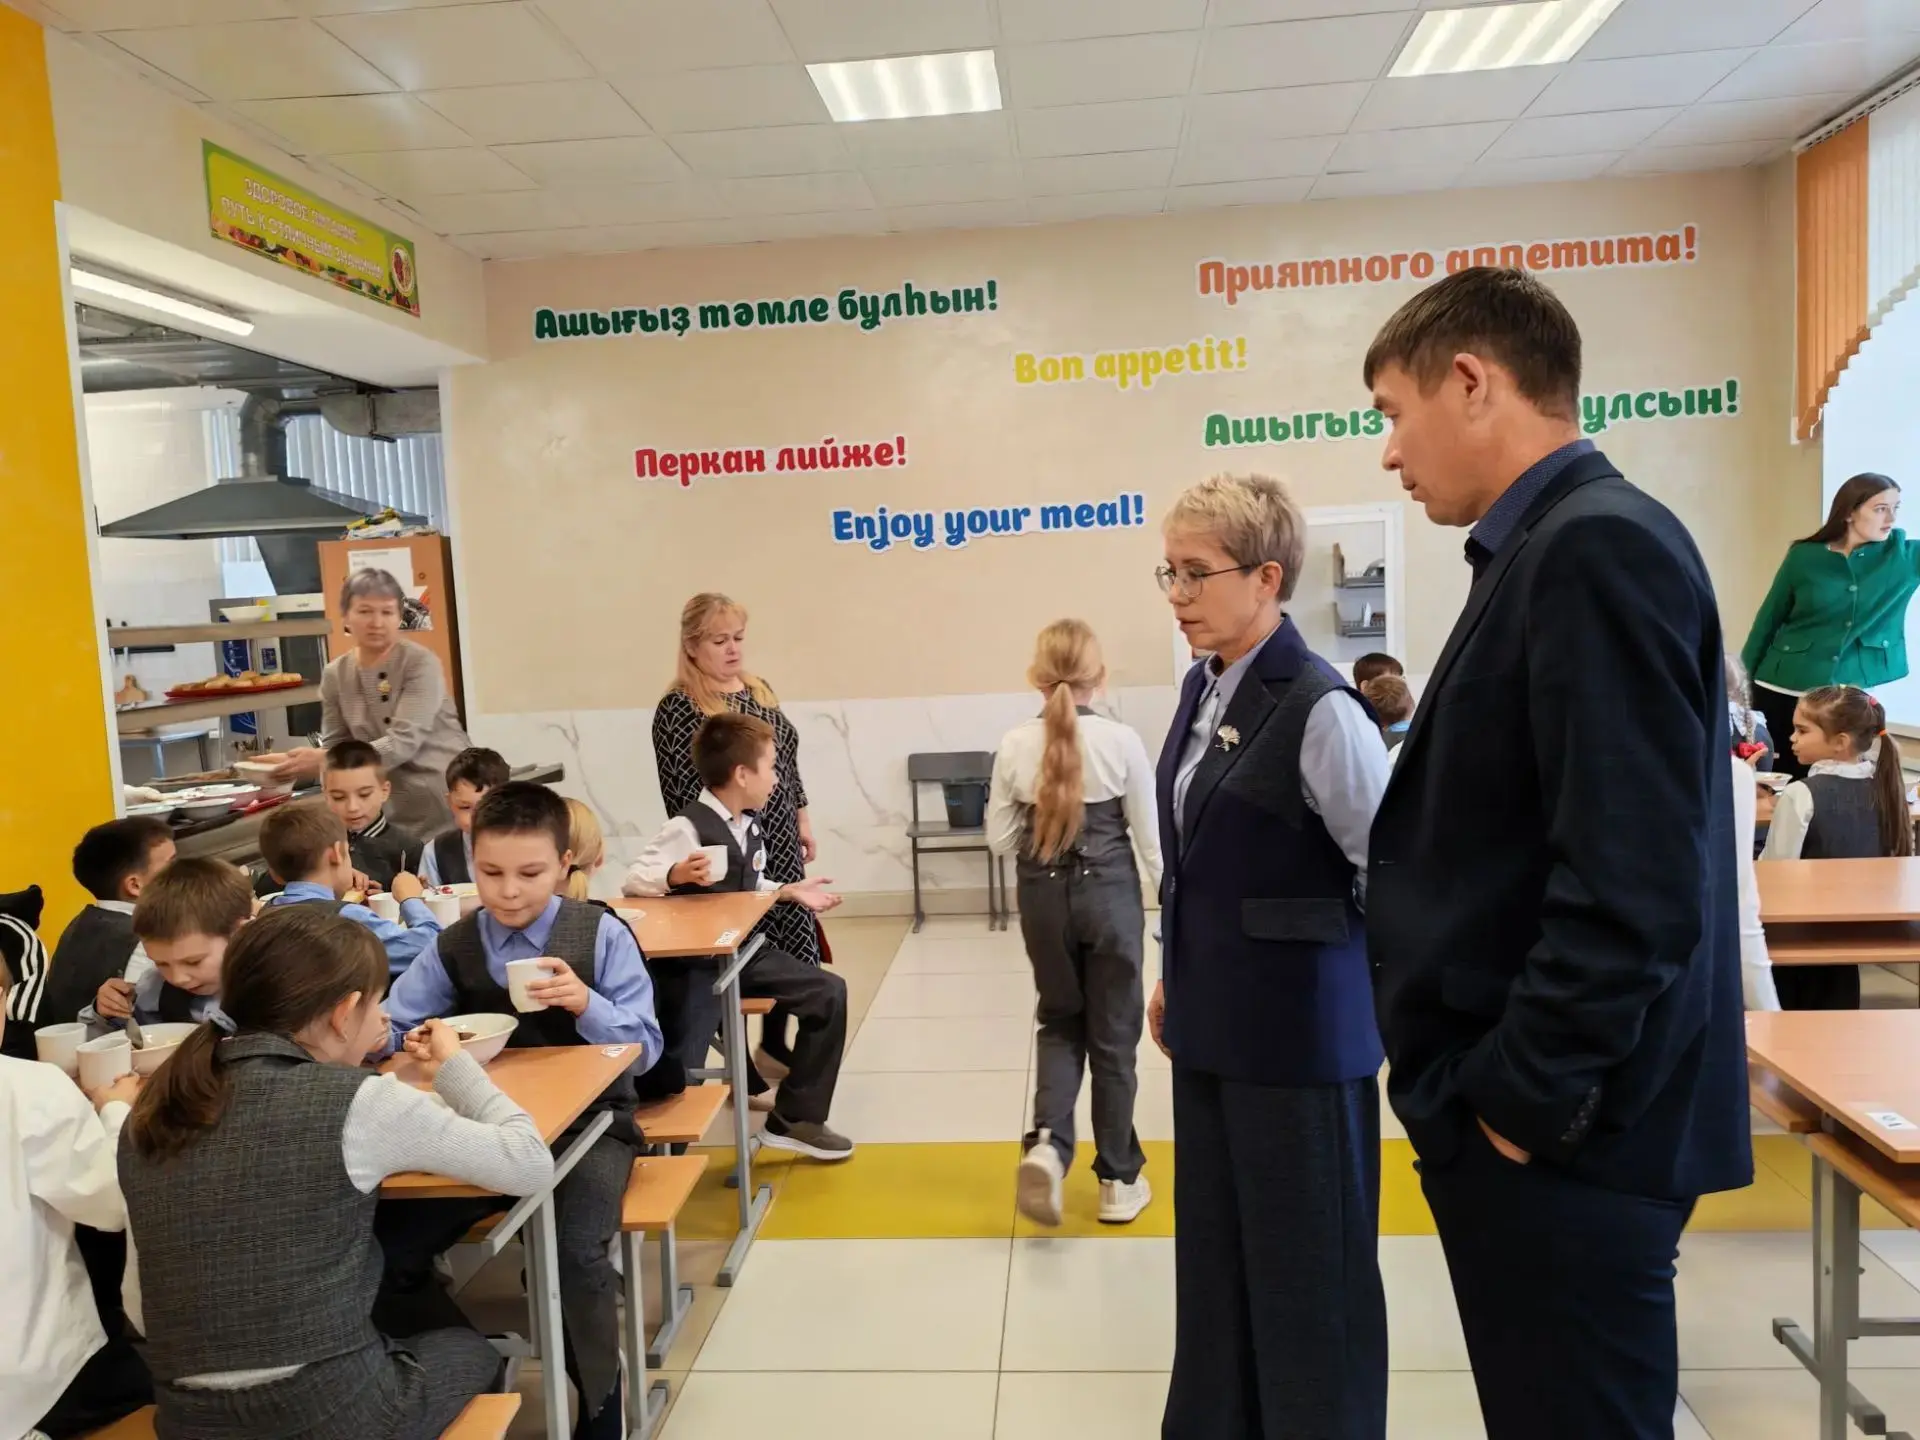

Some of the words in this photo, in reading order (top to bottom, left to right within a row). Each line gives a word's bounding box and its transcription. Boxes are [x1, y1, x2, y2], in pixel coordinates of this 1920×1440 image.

[221, 196, 255, 226] ПУТЬ
[258, 212, 267, 231] К
[244, 178, 308, 221] ЗДОРОВОЕ
[1199, 252, 1435, 304] Приятного
[1446, 226, 1697, 275] аппетита!
[1014, 351, 1085, 384] Bon
[1093, 337, 1248, 389] appetit!
[1203, 409, 1384, 447] Ашыгыз
[1580, 380, 1738, 436] улсын!
[634, 447, 766, 488] Перкан
[774, 435, 906, 473] лийже!
[832, 508, 936, 550] Enjoy
[944, 508, 1031, 548] your
[1039, 495, 1145, 530] meal!
